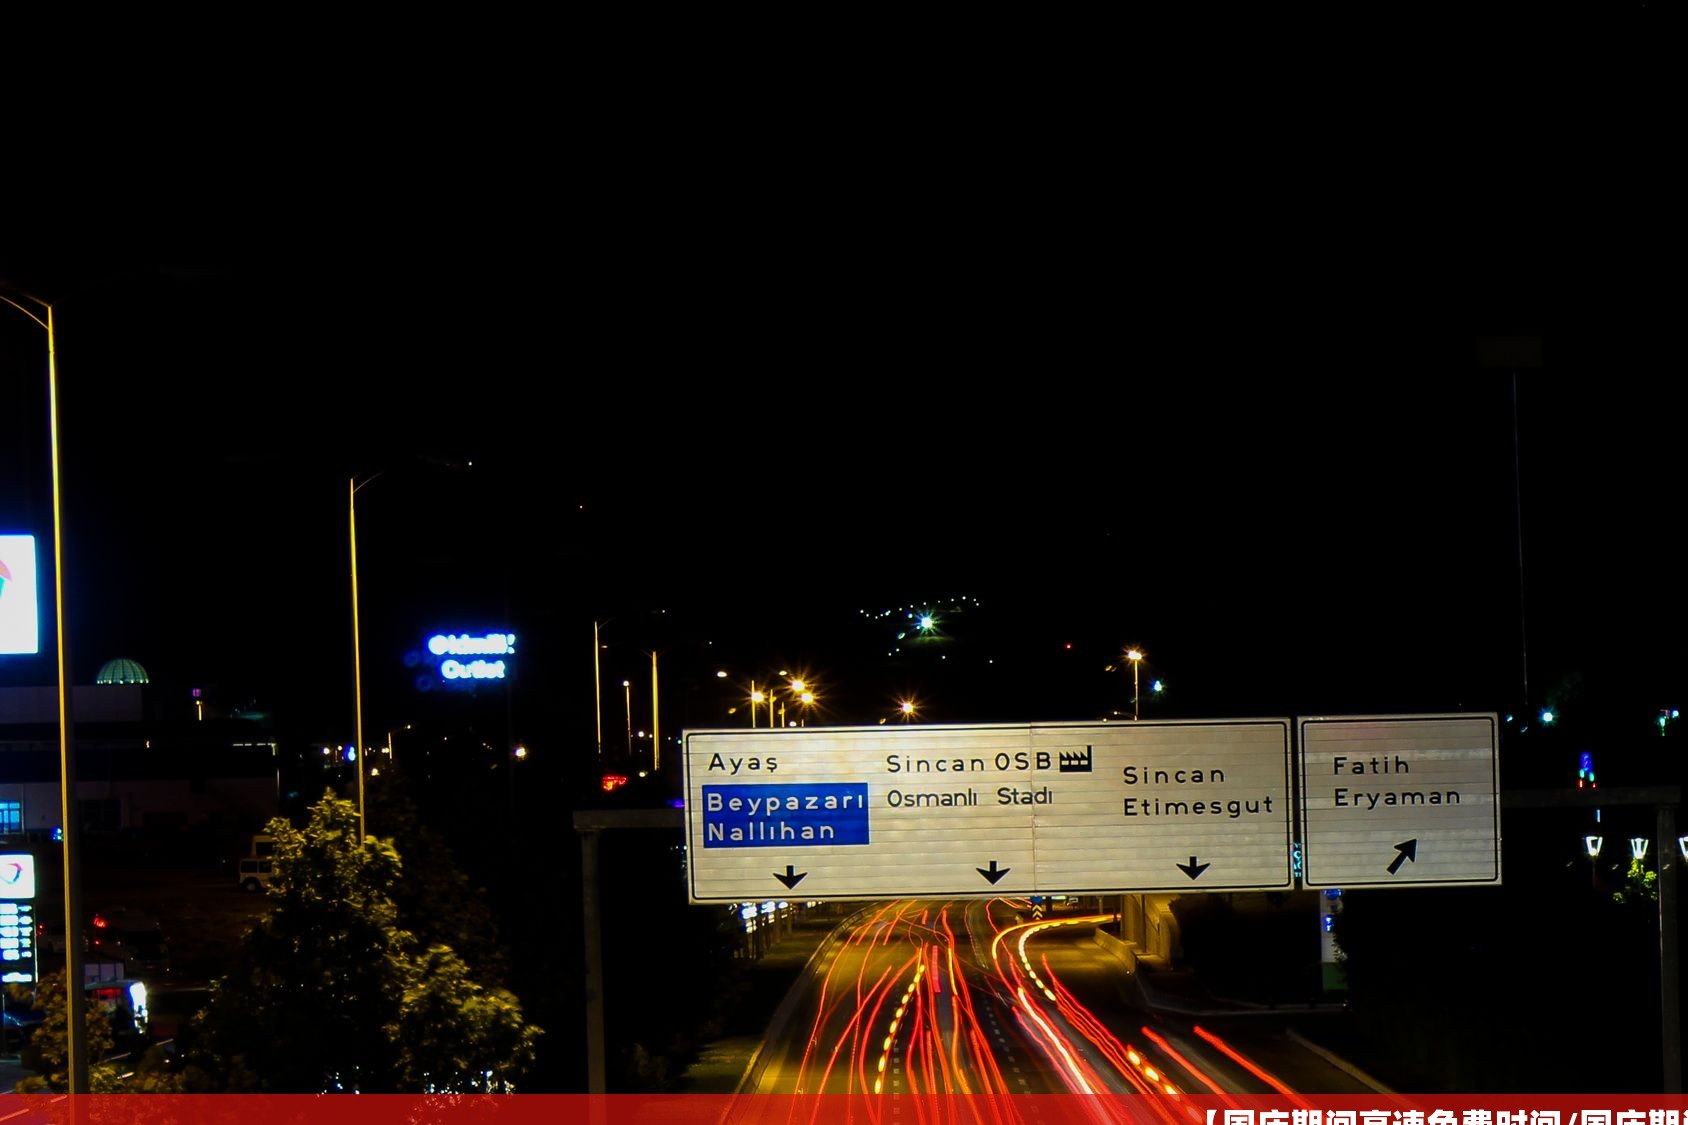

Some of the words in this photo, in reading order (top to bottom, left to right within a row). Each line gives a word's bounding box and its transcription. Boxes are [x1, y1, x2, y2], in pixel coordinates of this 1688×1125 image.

[708, 753, 777, 775] Ayaş
[887, 755, 984, 773] Sincan
[994, 752, 1051, 771] OSB
[1334, 755, 1409, 775] Fatih
[1123, 766, 1225, 785] Sincan
[707, 792, 863, 816] Beypazarı
[887, 787, 977, 807] Osmanlı
[997, 786, 1053, 805] Stadı
[1123, 796, 1273, 818] Etimesgut
[1335, 788, 1461, 810] Eryaman
[708, 820, 835, 841] Nallıhan
